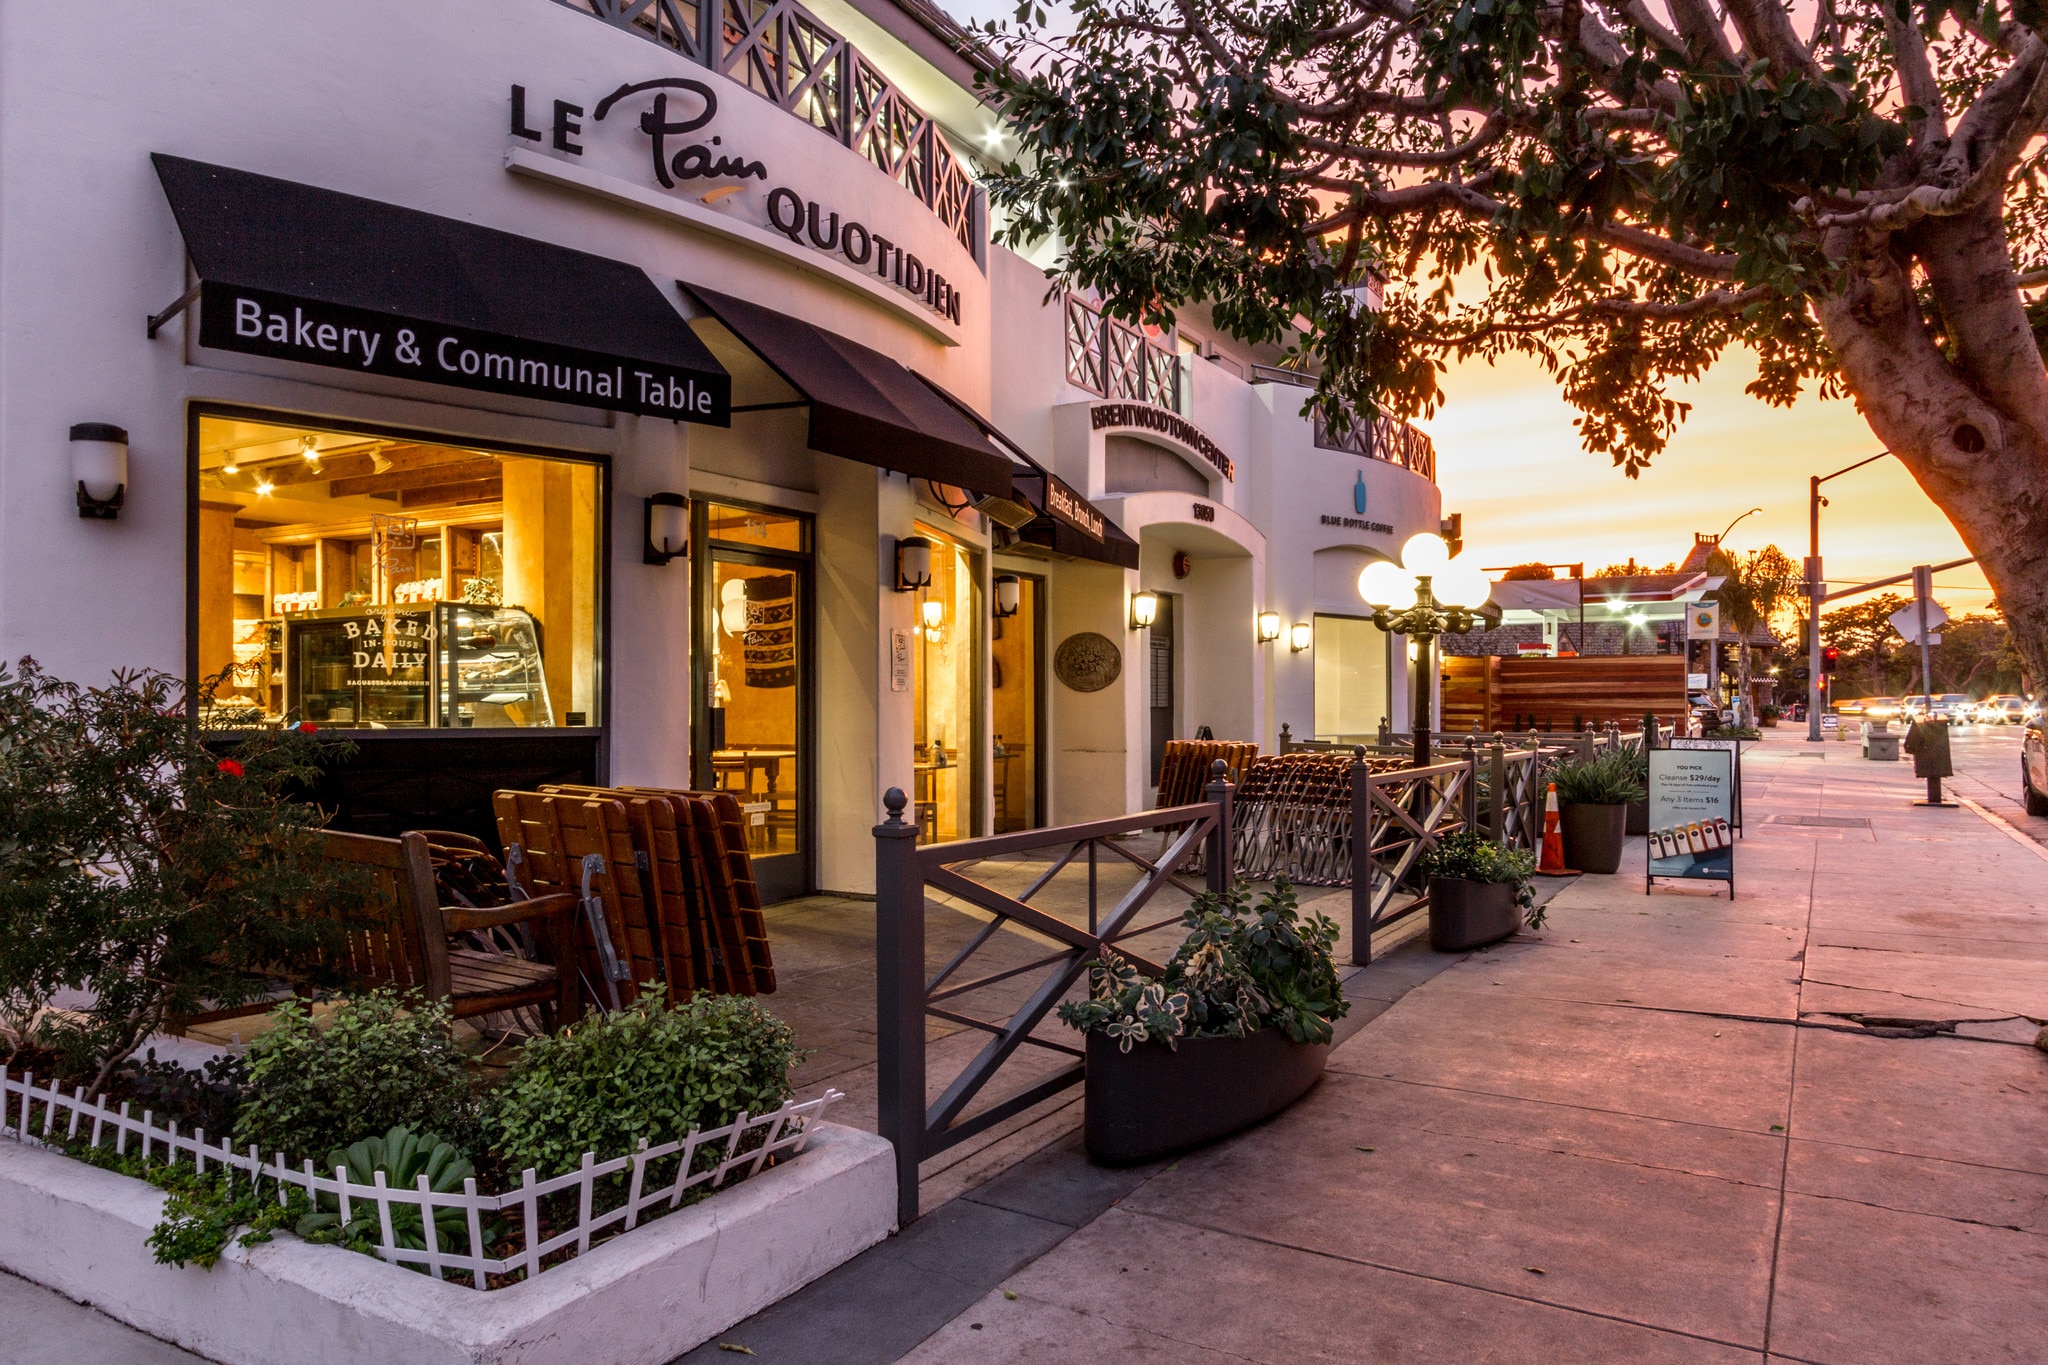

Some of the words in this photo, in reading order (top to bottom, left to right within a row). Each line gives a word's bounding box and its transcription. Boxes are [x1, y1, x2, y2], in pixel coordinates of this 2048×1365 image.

[510, 84, 584, 156] LE
[592, 77, 768, 190] Pain
[766, 186, 961, 327] QUOTIDIEN
[235, 298, 381, 367] Bakery
[395, 328, 422, 367] &
[437, 336, 624, 399] Communal
[634, 370, 713, 414] Table
[1091, 404, 1169, 430] BRENTWOOD
[1168, 414, 1199, 450] TOWN
[1198, 433, 1235, 483] CENTER
[744, 518, 767, 539] 114
[1320, 514, 1342, 526] BLUE
[1343, 517, 1370, 531] BOTTLE
[1370, 522, 1394, 535] COFFEE
[365, 608, 418, 622] organic
[343, 618, 439, 641] BAKED
[363, 640, 419, 649] IN-HOUSE
[353, 651, 427, 668] DAILY
[1659, 773, 1688, 781] Cleanse
[1689, 774, 1720, 783] $29/day
[1660, 795, 1676, 804] Any
[1705, 796, 1719, 804] $16
